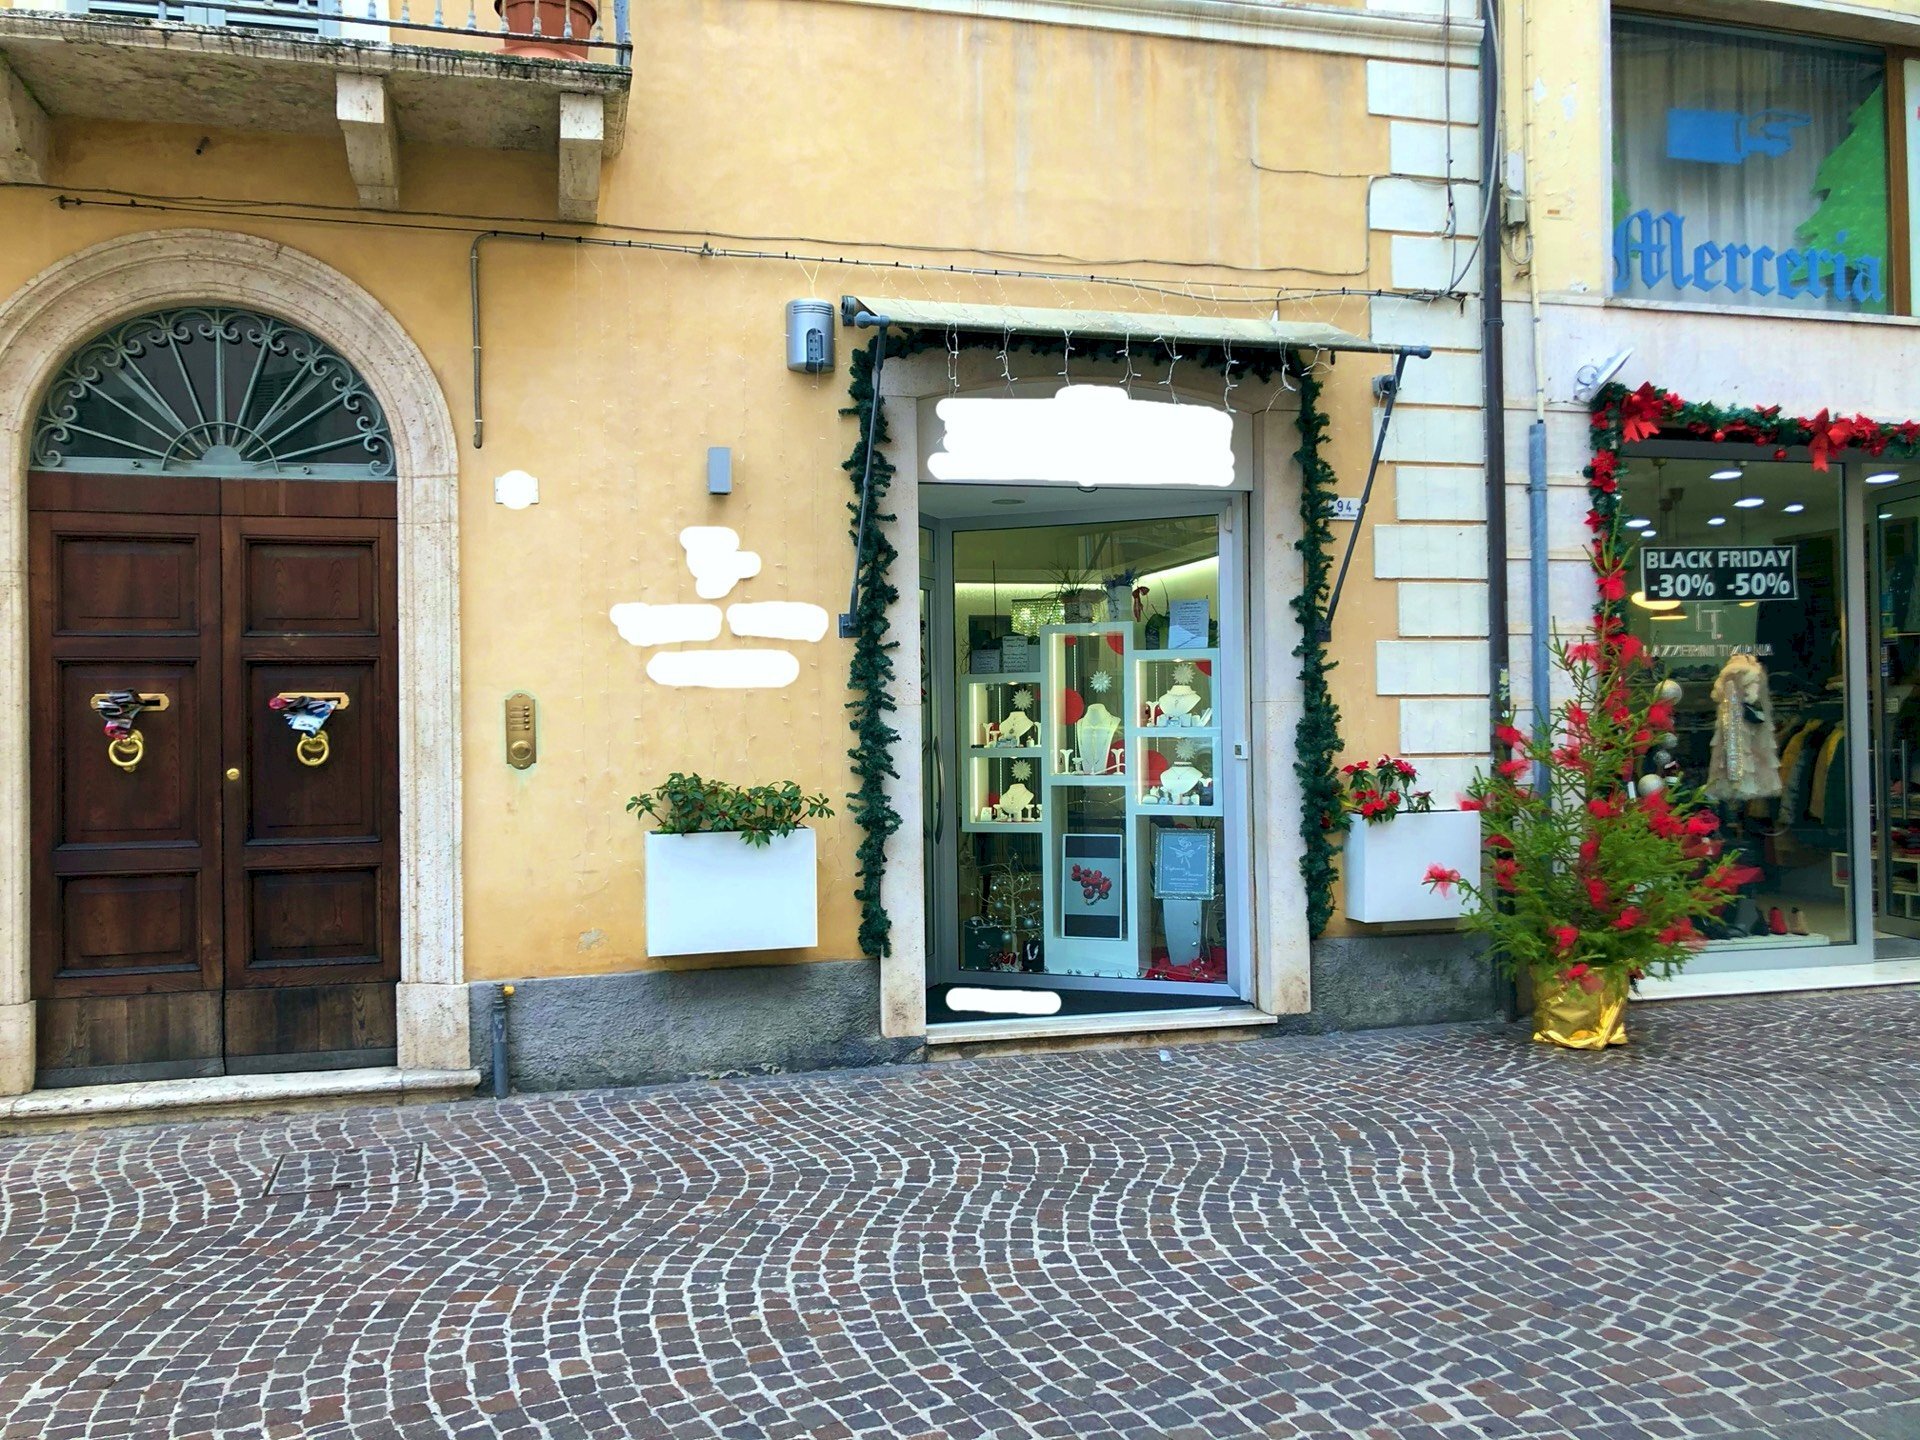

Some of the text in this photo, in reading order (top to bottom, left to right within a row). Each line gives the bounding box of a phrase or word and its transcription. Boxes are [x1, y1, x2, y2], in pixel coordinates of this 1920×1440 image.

[1612, 208, 1885, 304] Merceria
[1336, 500, 1352, 512] 94
[1646, 550, 1791, 569] BLACK FRIDAY
[1650, 572, 1791, 598] -30% -50%
